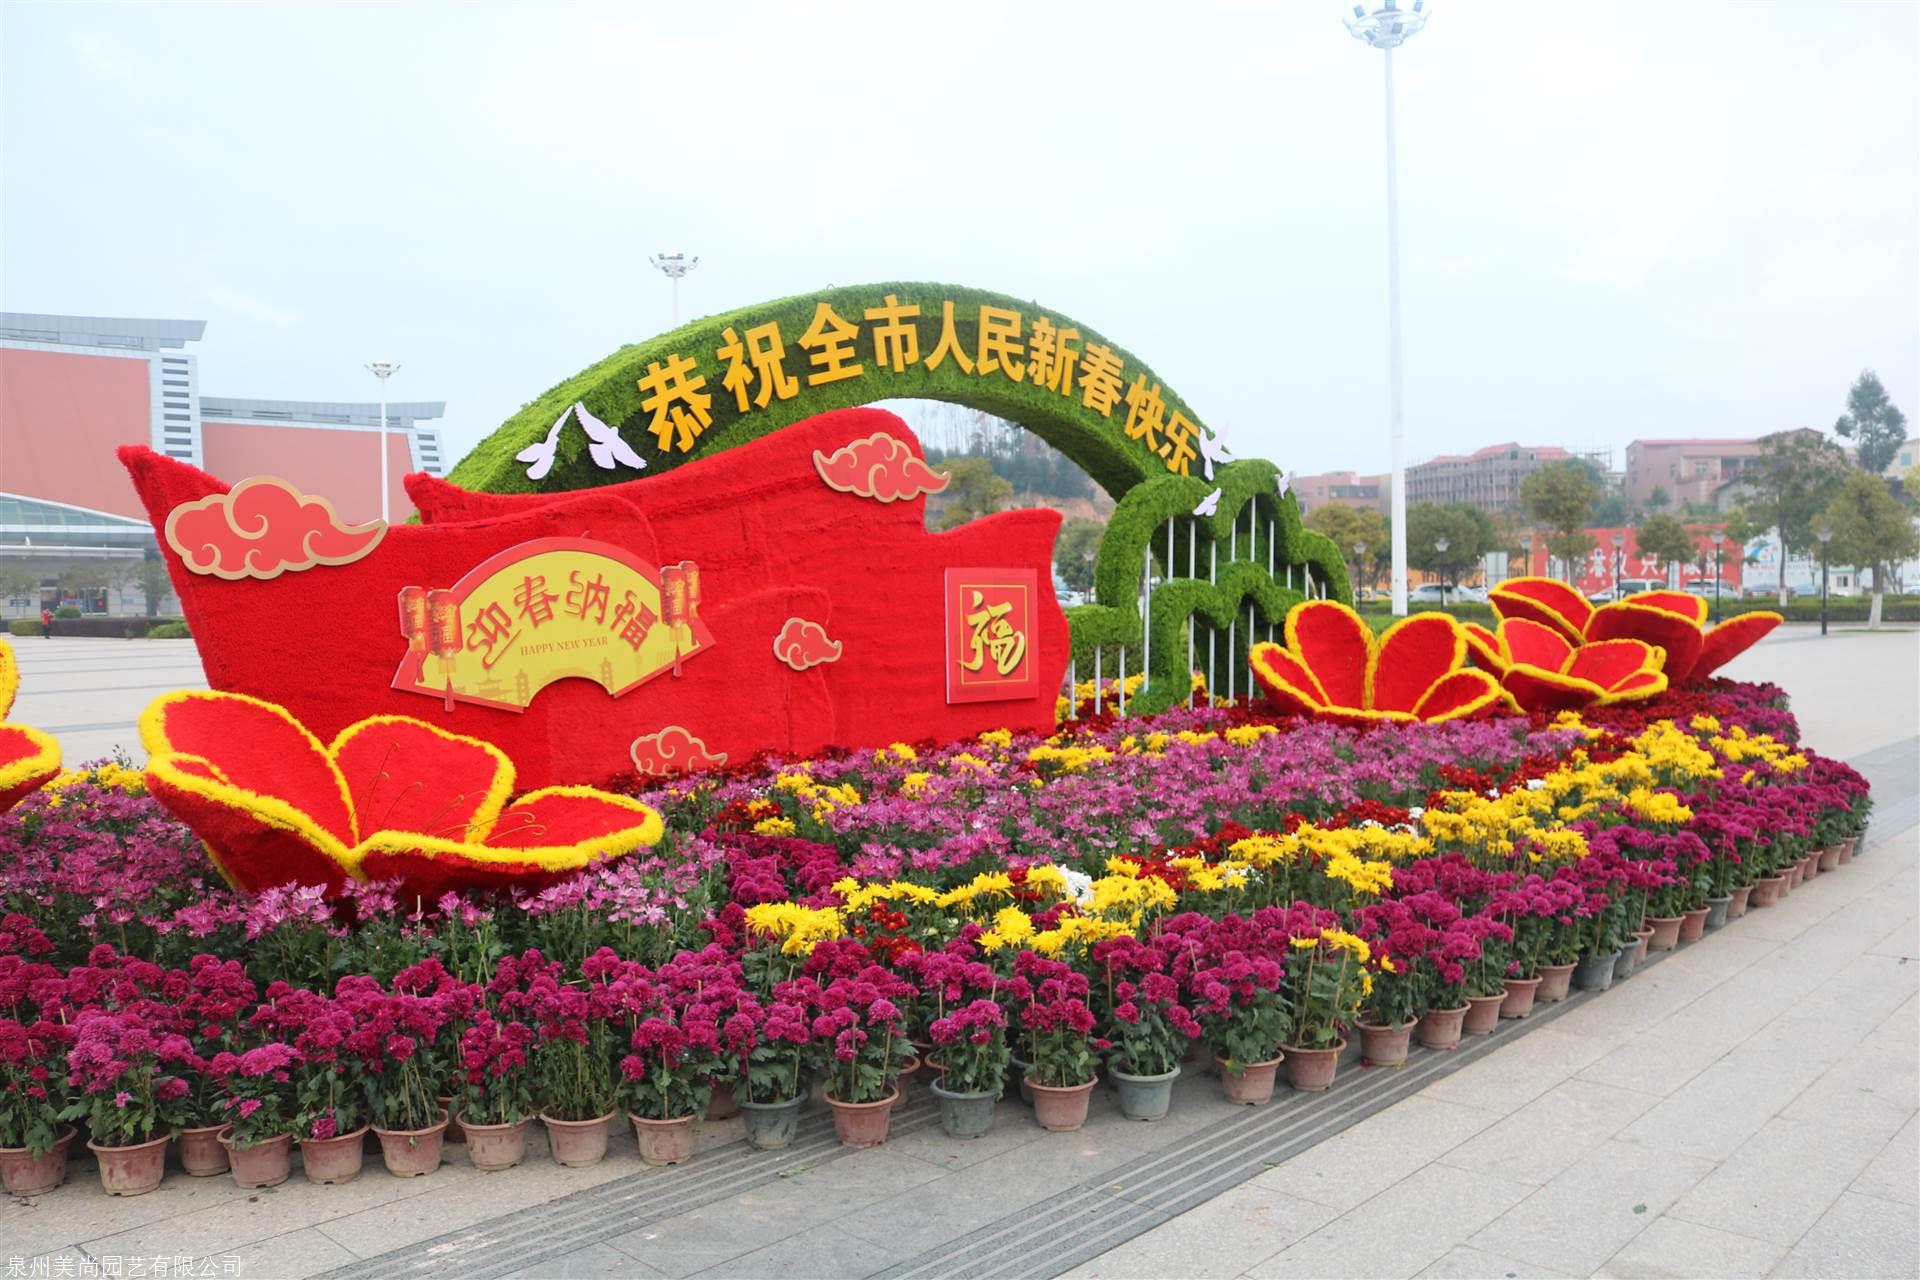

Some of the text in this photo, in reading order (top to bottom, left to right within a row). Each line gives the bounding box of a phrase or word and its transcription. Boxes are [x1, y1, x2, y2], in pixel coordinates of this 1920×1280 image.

[637, 294, 1200, 476] 恭祝全市人民新春快乐
[465, 569, 659, 670] 迎春纳福
[519, 635, 609, 657] HAPPY NEW YEAR
[957, 590, 1026, 676] 福
